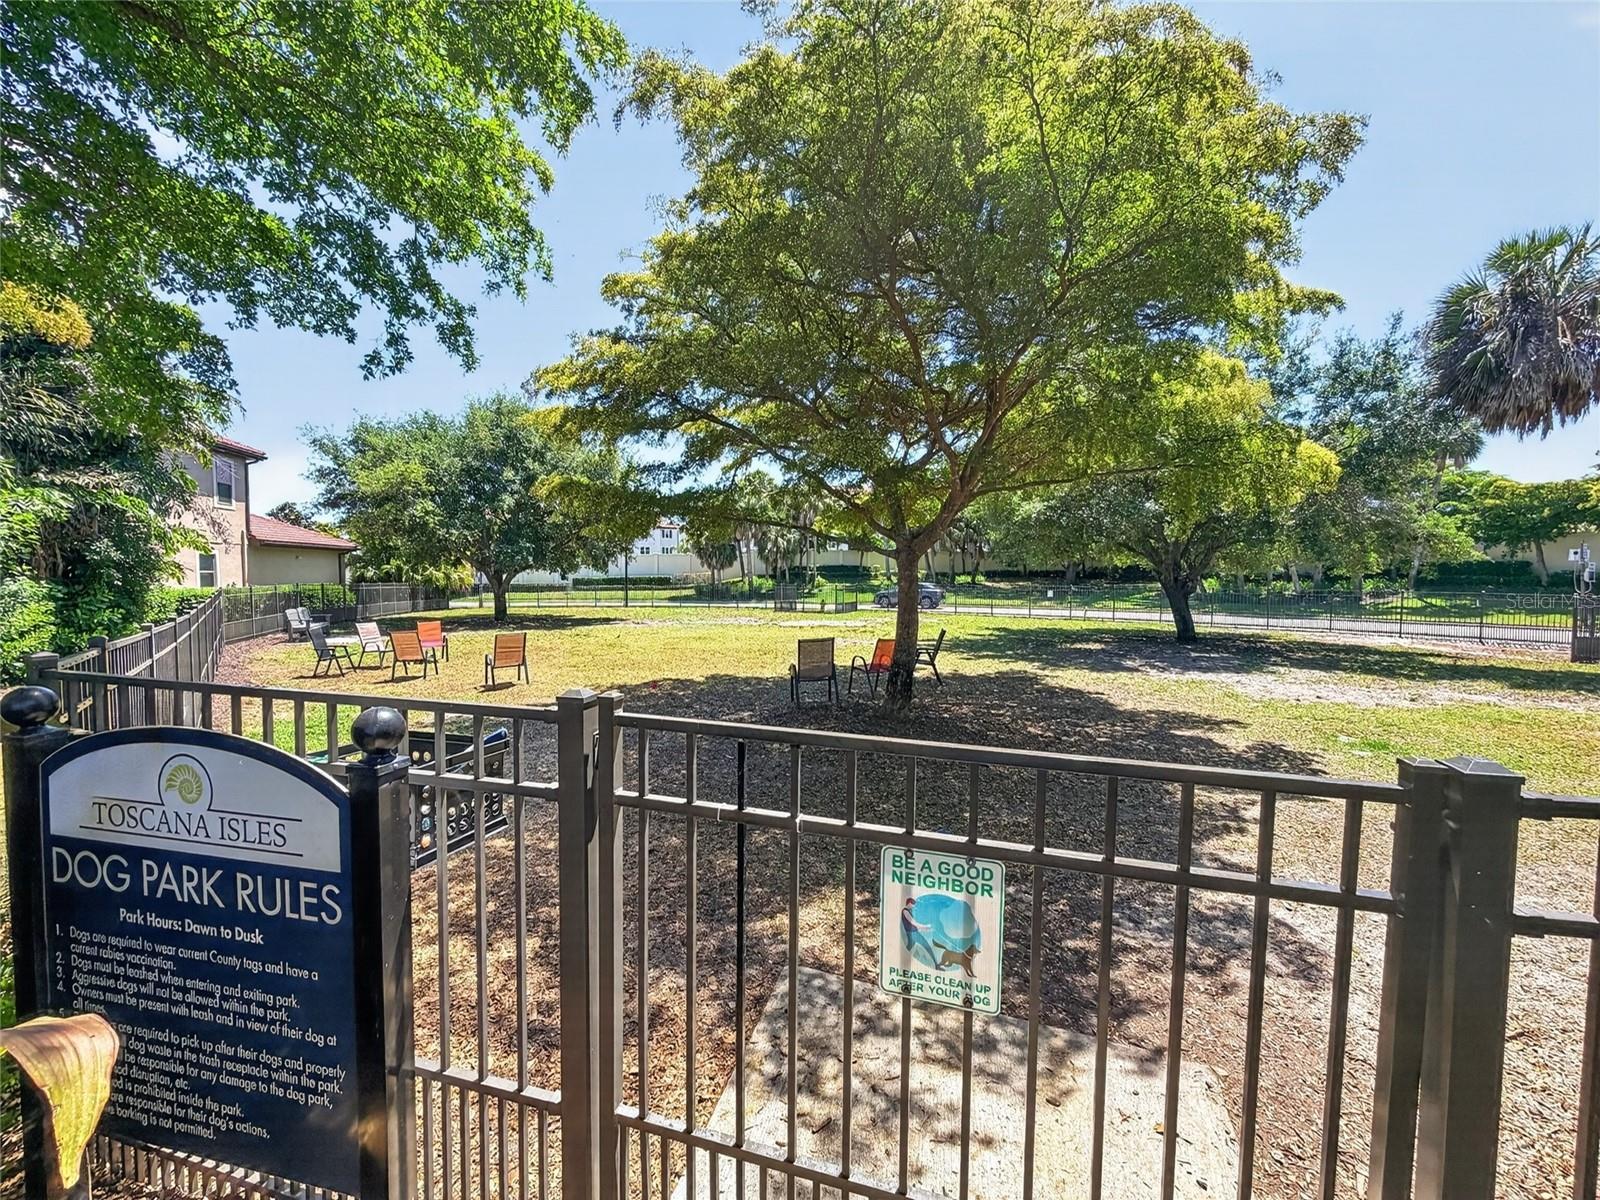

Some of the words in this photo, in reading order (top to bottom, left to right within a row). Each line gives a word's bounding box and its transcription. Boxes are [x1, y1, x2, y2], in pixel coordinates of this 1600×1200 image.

[92, 801, 210, 840] TOSCANA
[218, 816, 287, 848] ISLES
[52, 846, 131, 893] DOG
[142, 859, 225, 909] PARK
[236, 872, 343, 926] RULES
[891, 870, 994, 898] NEIGHBOR
[892, 854, 915, 871] BE
[920, 859, 933, 874] A
[938, 861, 994, 882] GOOD
[120, 908, 145, 925] Park
[147, 912, 182, 931] Hours:
[185, 919, 217, 937] Dawn
[220, 925, 232, 939] to
[235, 927, 264, 944] Dusk
[56, 924, 63, 936] 1.
[70, 926, 91, 943] Dogs
[92, 933, 107, 943] are
[108, 935, 142, 950] required
[144, 940, 153, 952] to
[154, 944, 177, 955] wear
[178, 947, 208, 961] current
[209, 950, 241, 971] County
[243, 957, 263, 973] tags
[265, 961, 283, 974] and
[286, 962, 309, 980] have
[311, 971, 318, 981] a
[70, 943, 98, 956] current
[100, 946, 125, 961] rabies
[126, 953, 177, 971] vaccination.
[56, 951, 65, 964] 2.
[71, 955, 92, 971] Dogs
[94, 961, 112, 973] must
[114, 961, 125, 975] be
[127, 963, 159, 981] leashed
[160, 971, 184, 987] when
[186, 978, 221, 996] entering
[223, 984, 241, 998] and
[243, 989, 273, 1006] exiting
[276, 994, 301, 1008] park.
[56, 965, 66, 978] 3.
[72, 969, 116, 988] Aggressive
[117, 977, 138, 994] dogs
[139, 982, 154, 996] will
[156, 987, 170, 999] not
[171, 987, 183, 1001] be
[184, 990, 219, 1008] allowed
[221, 998, 248, 1014] within
[250, 1002, 265, 1017] the
[266, 1008, 291, 1022] park.
[889, 966, 931, 983] PLEASE
[935, 975, 973, 992] CLEAN
[975, 983, 992, 995] UP
[928, 985, 960, 1001] YOUR
[56, 980, 66, 992] 4.
[72, 983, 104, 1000] Owners
[105, 992, 124, 1005] must
[125, 992, 137, 1006] be
[139, 999, 169, 1012] present
[171, 1004, 189, 1016] with
[190, 1004, 214, 1021] leash
[216, 1012, 233, 1026] and
[236, 1015, 245, 1028] in
[246, 1018, 268, 1033] view
[270, 1022, 280, 1036] of
[281, 1024, 302, 1040] their
[305, 1028, 324, 1047] dog
[327, 1035, 337, 1046] at
[73, 997, 83, 1009] all
[128, 1037, 146, 1055] dog
[147, 1043, 172, 1057] waste
[173, 1046, 182, 1059] in
[183, 1048, 197, 1062] the
[199, 1052, 220, 1068] trash
[222, 1061, 269, 1078] receptacle
[271, 1069, 298, 1085] within
[300, 1073, 315, 1089] the
[318, 1080, 343, 1095] park.
[133, 1026, 169, 1043] required
[171, 1031, 180, 1044] to
[181, 1035, 200, 1049] pick
[201, 1039, 213, 1054] up
[215, 1040, 235, 1056] after
[237, 1044, 258, 1060] their
[259, 1049, 282, 1069] dogs
[284, 1057, 303, 1070] and
[305, 1064, 346, 1082] properly
[124, 1049, 136, 1063] be
[137, 1055, 185, 1075] responsible
[186, 1064, 199, 1077] for
[200, 1070, 218, 1085] any
[219, 1070, 257, 1093] damage
[258, 1081, 268, 1093] to
[269, 1082, 285, 1097] the
[286, 1086, 306, 1104] dog
[308, 1093, 333, 1110] park,
[130, 1065, 173, 1088] disruption,
[175, 1078, 191, 1090] etc.
[116, 1102, 148, 1126] barking
[150, 1113, 158, 1126] is
[158, 1117, 172, 1130] not
[125, 1079, 132, 1091] is
[133, 1083, 176, 1101] prohibited
[178, 1091, 204, 1105] inside
[205, 1096, 220, 1111] the
[221, 1102, 245, 1118] park.
[125, 1095, 172, 1115] responsible
[173, 1102, 186, 1118] for
[187, 1107, 206, 1123] their
[208, 1113, 234, 1131] dog's
